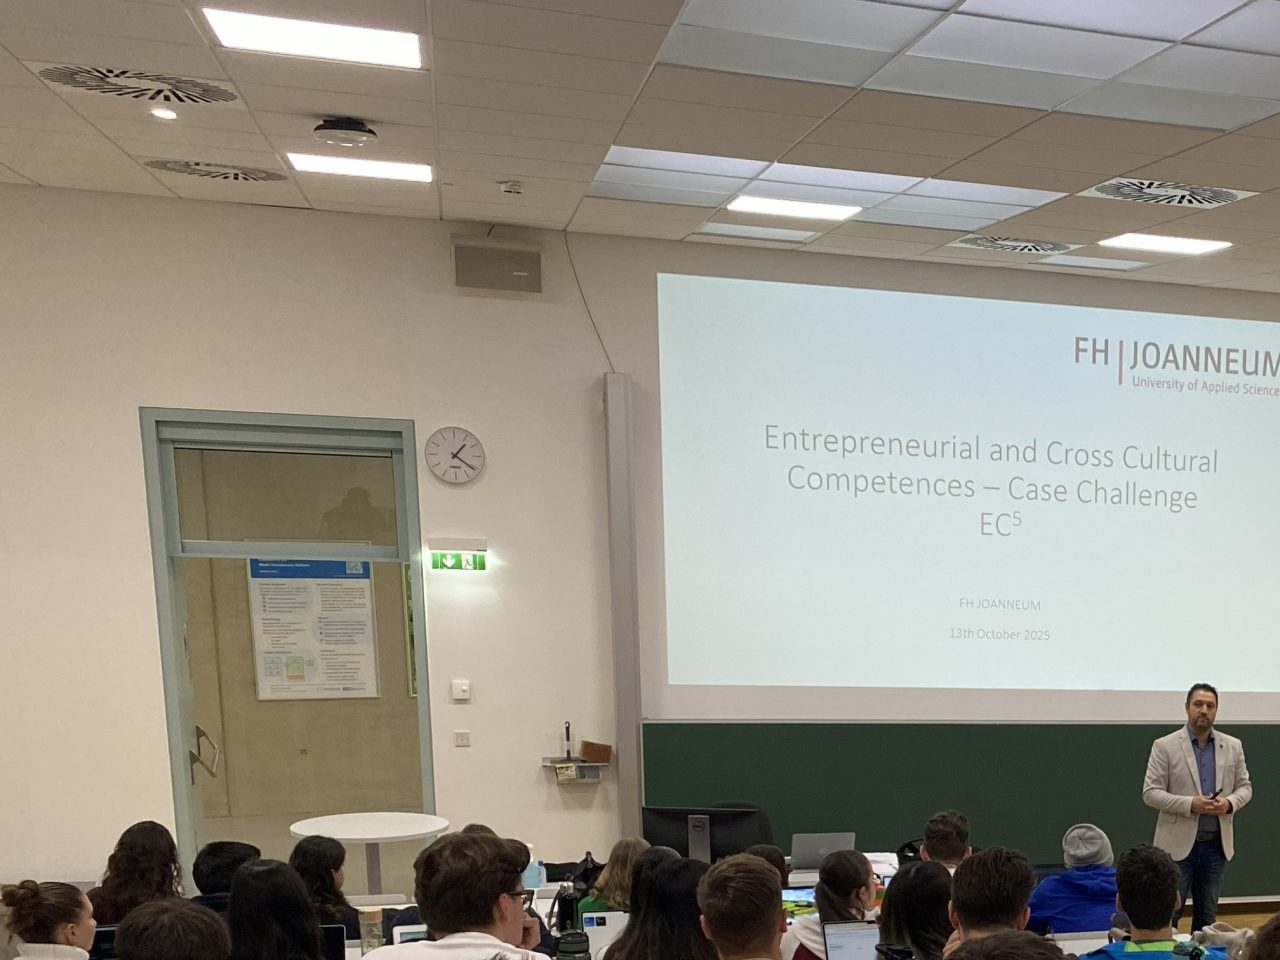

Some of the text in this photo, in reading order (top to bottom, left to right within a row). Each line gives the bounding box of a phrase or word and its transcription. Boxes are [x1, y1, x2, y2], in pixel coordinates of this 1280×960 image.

[1074, 336, 1109, 365] FH
[1132, 375, 1184, 392] University
[1187, 377, 1199, 390] of
[1201, 379, 1240, 396] Applied
[765, 424, 1218, 473] Entrepreneurial and Cross Cultural
[787, 464, 975, 498] Competences
[1008, 476, 1067, 502] Case
[1077, 479, 1198, 513] Challenge
[959, 598, 1041, 610] FH JOANNEUM
[950, 628, 1051, 641] 13th October 2025
